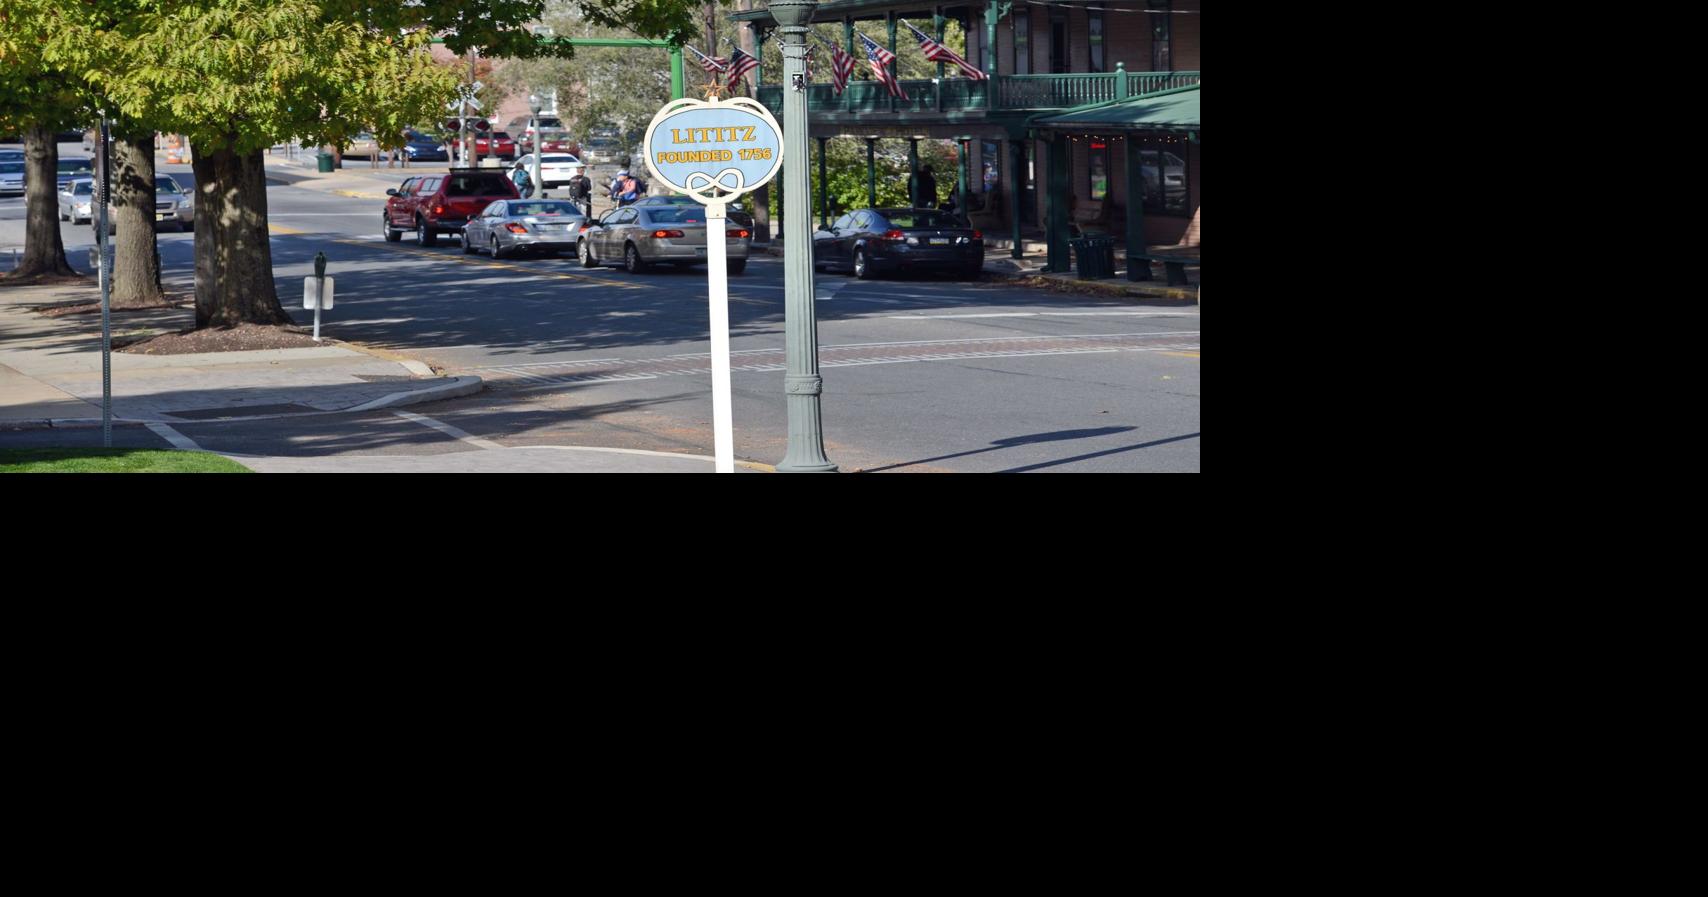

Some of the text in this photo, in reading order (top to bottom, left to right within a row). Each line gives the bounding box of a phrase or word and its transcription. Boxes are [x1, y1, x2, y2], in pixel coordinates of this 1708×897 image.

[670, 125, 756, 144] LITITZ
[657, 148, 772, 164] FOUNDED 1756
